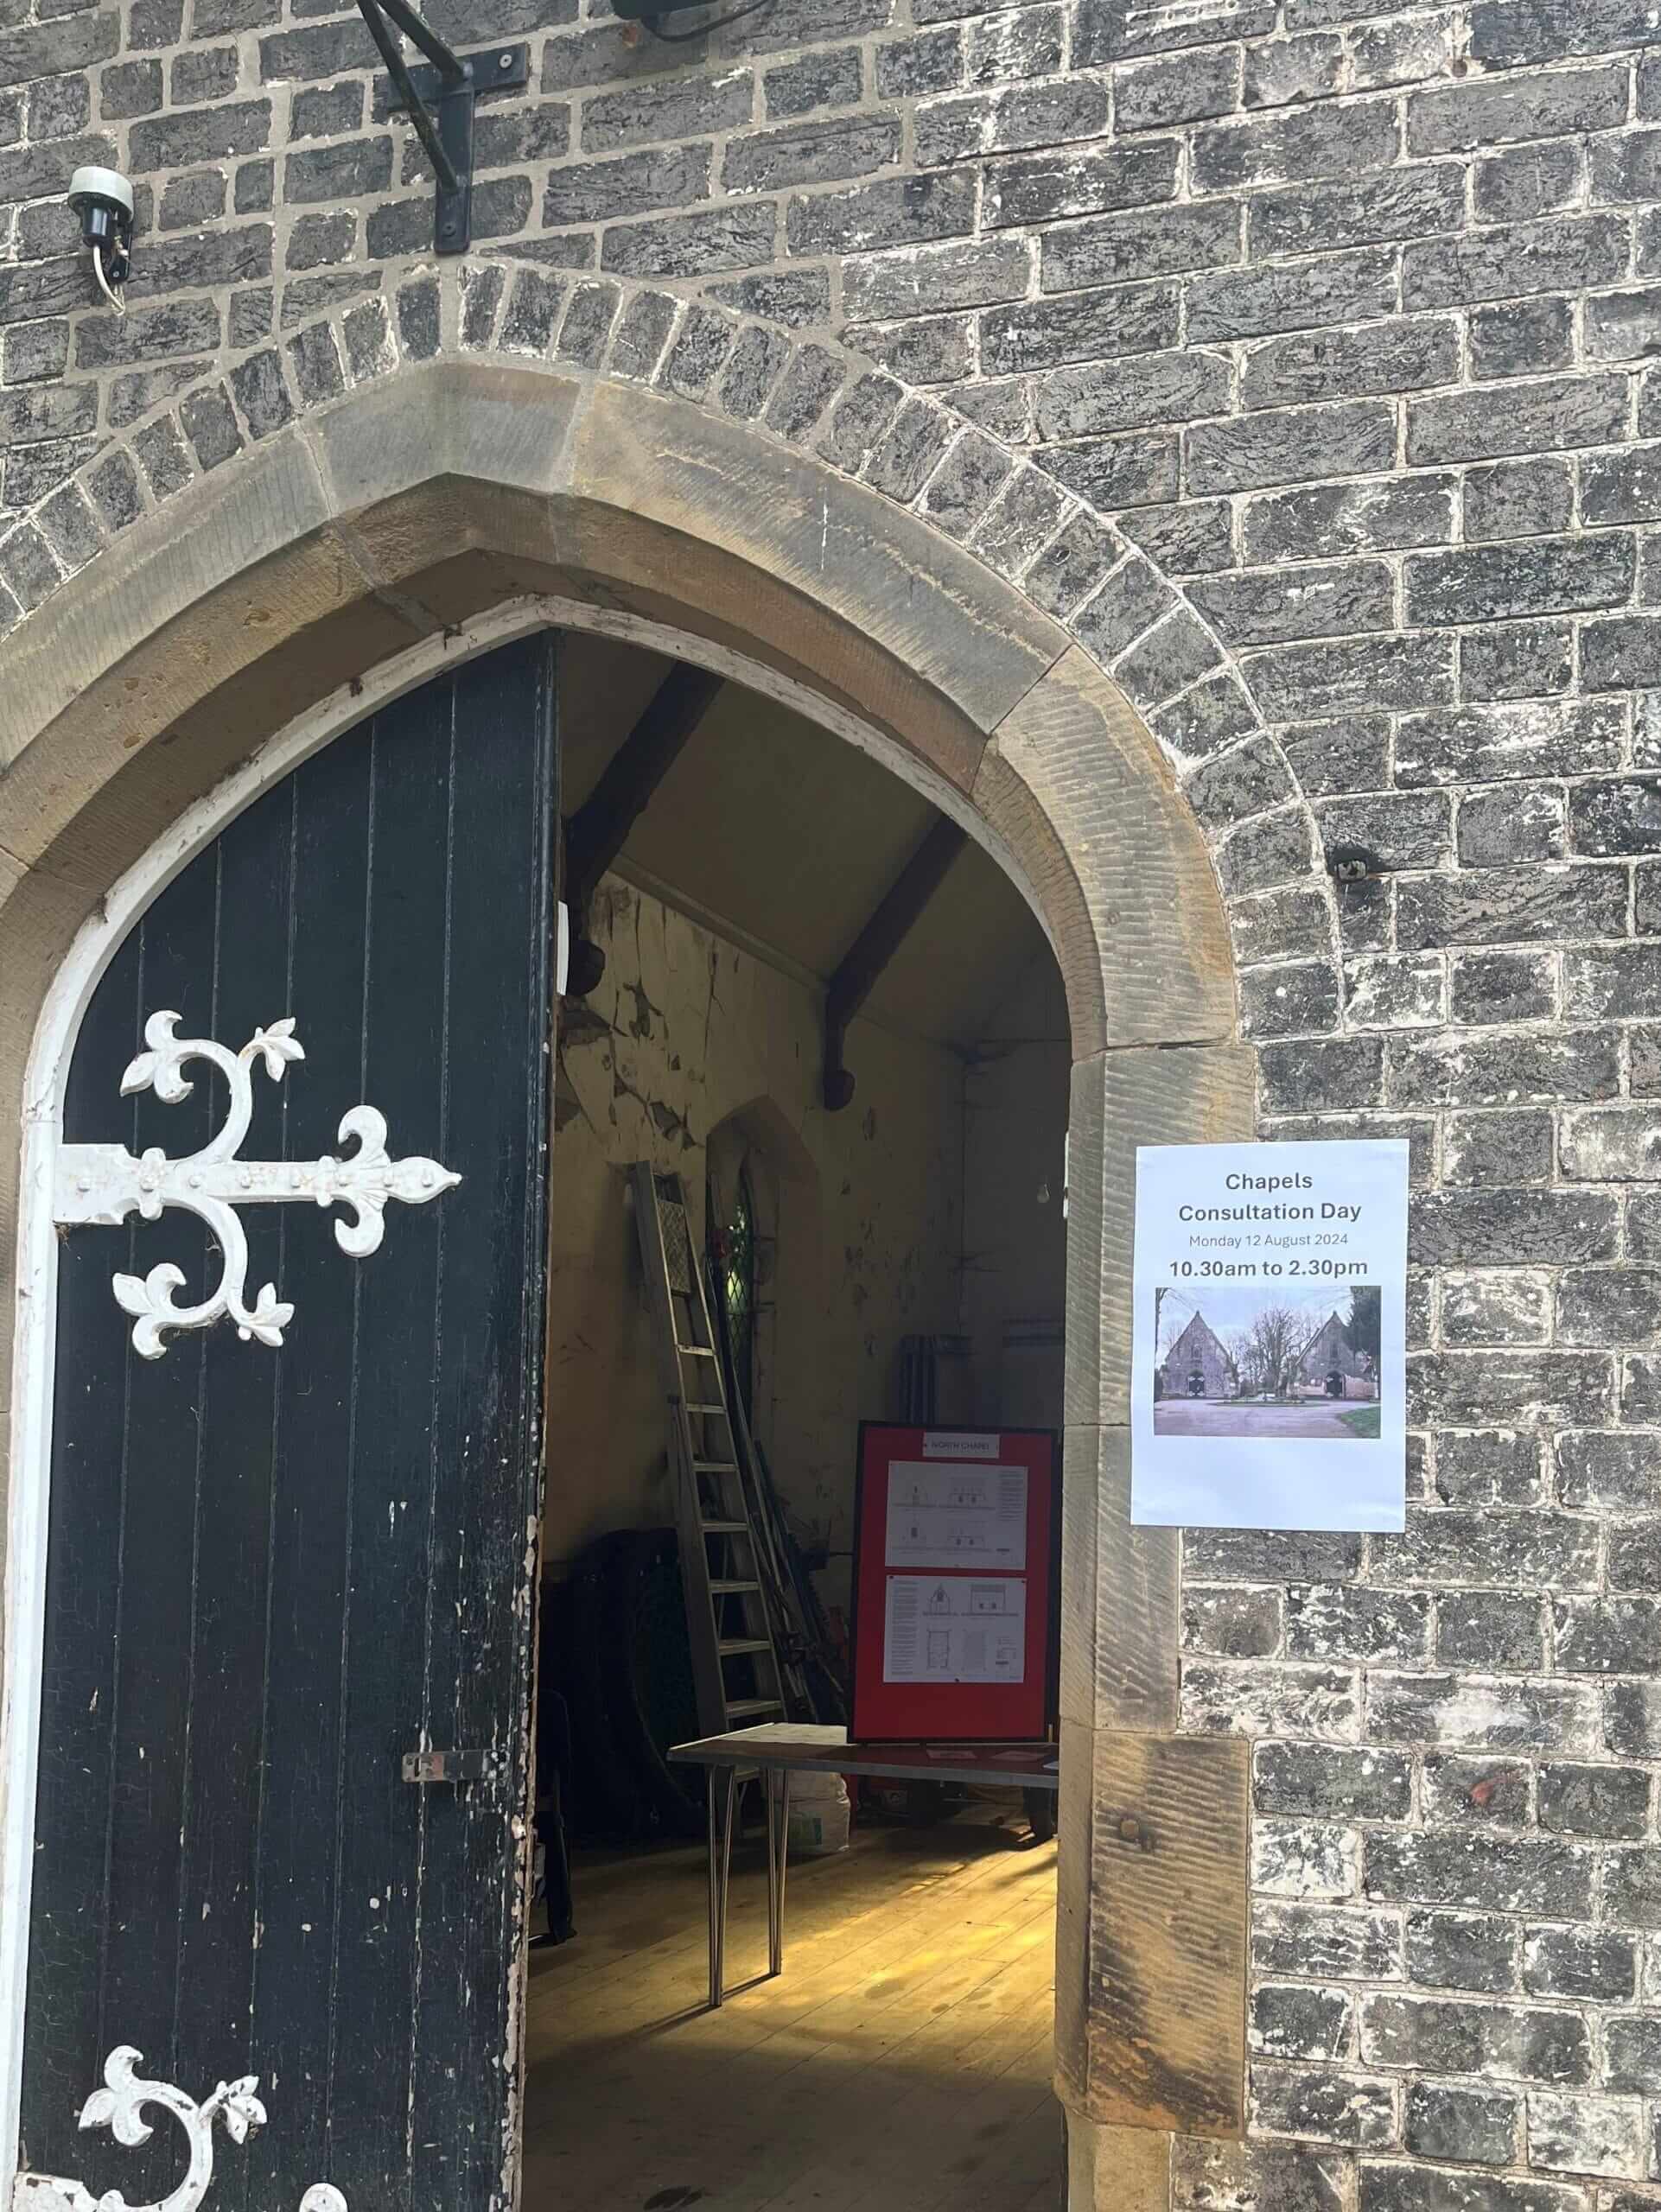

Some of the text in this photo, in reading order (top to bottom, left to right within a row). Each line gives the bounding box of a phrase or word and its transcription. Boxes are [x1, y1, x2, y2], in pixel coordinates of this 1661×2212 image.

[1225, 1173, 1313, 1193] Chapels
[1179, 1202, 1362, 1222] Consultation Day
[1189, 1233, 1348, 1249] Monday 12 August 2024
[1169, 1260, 1368, 1279] 10.30am to 2.30pm
[932, 1440, 958, 1451] NORTH
